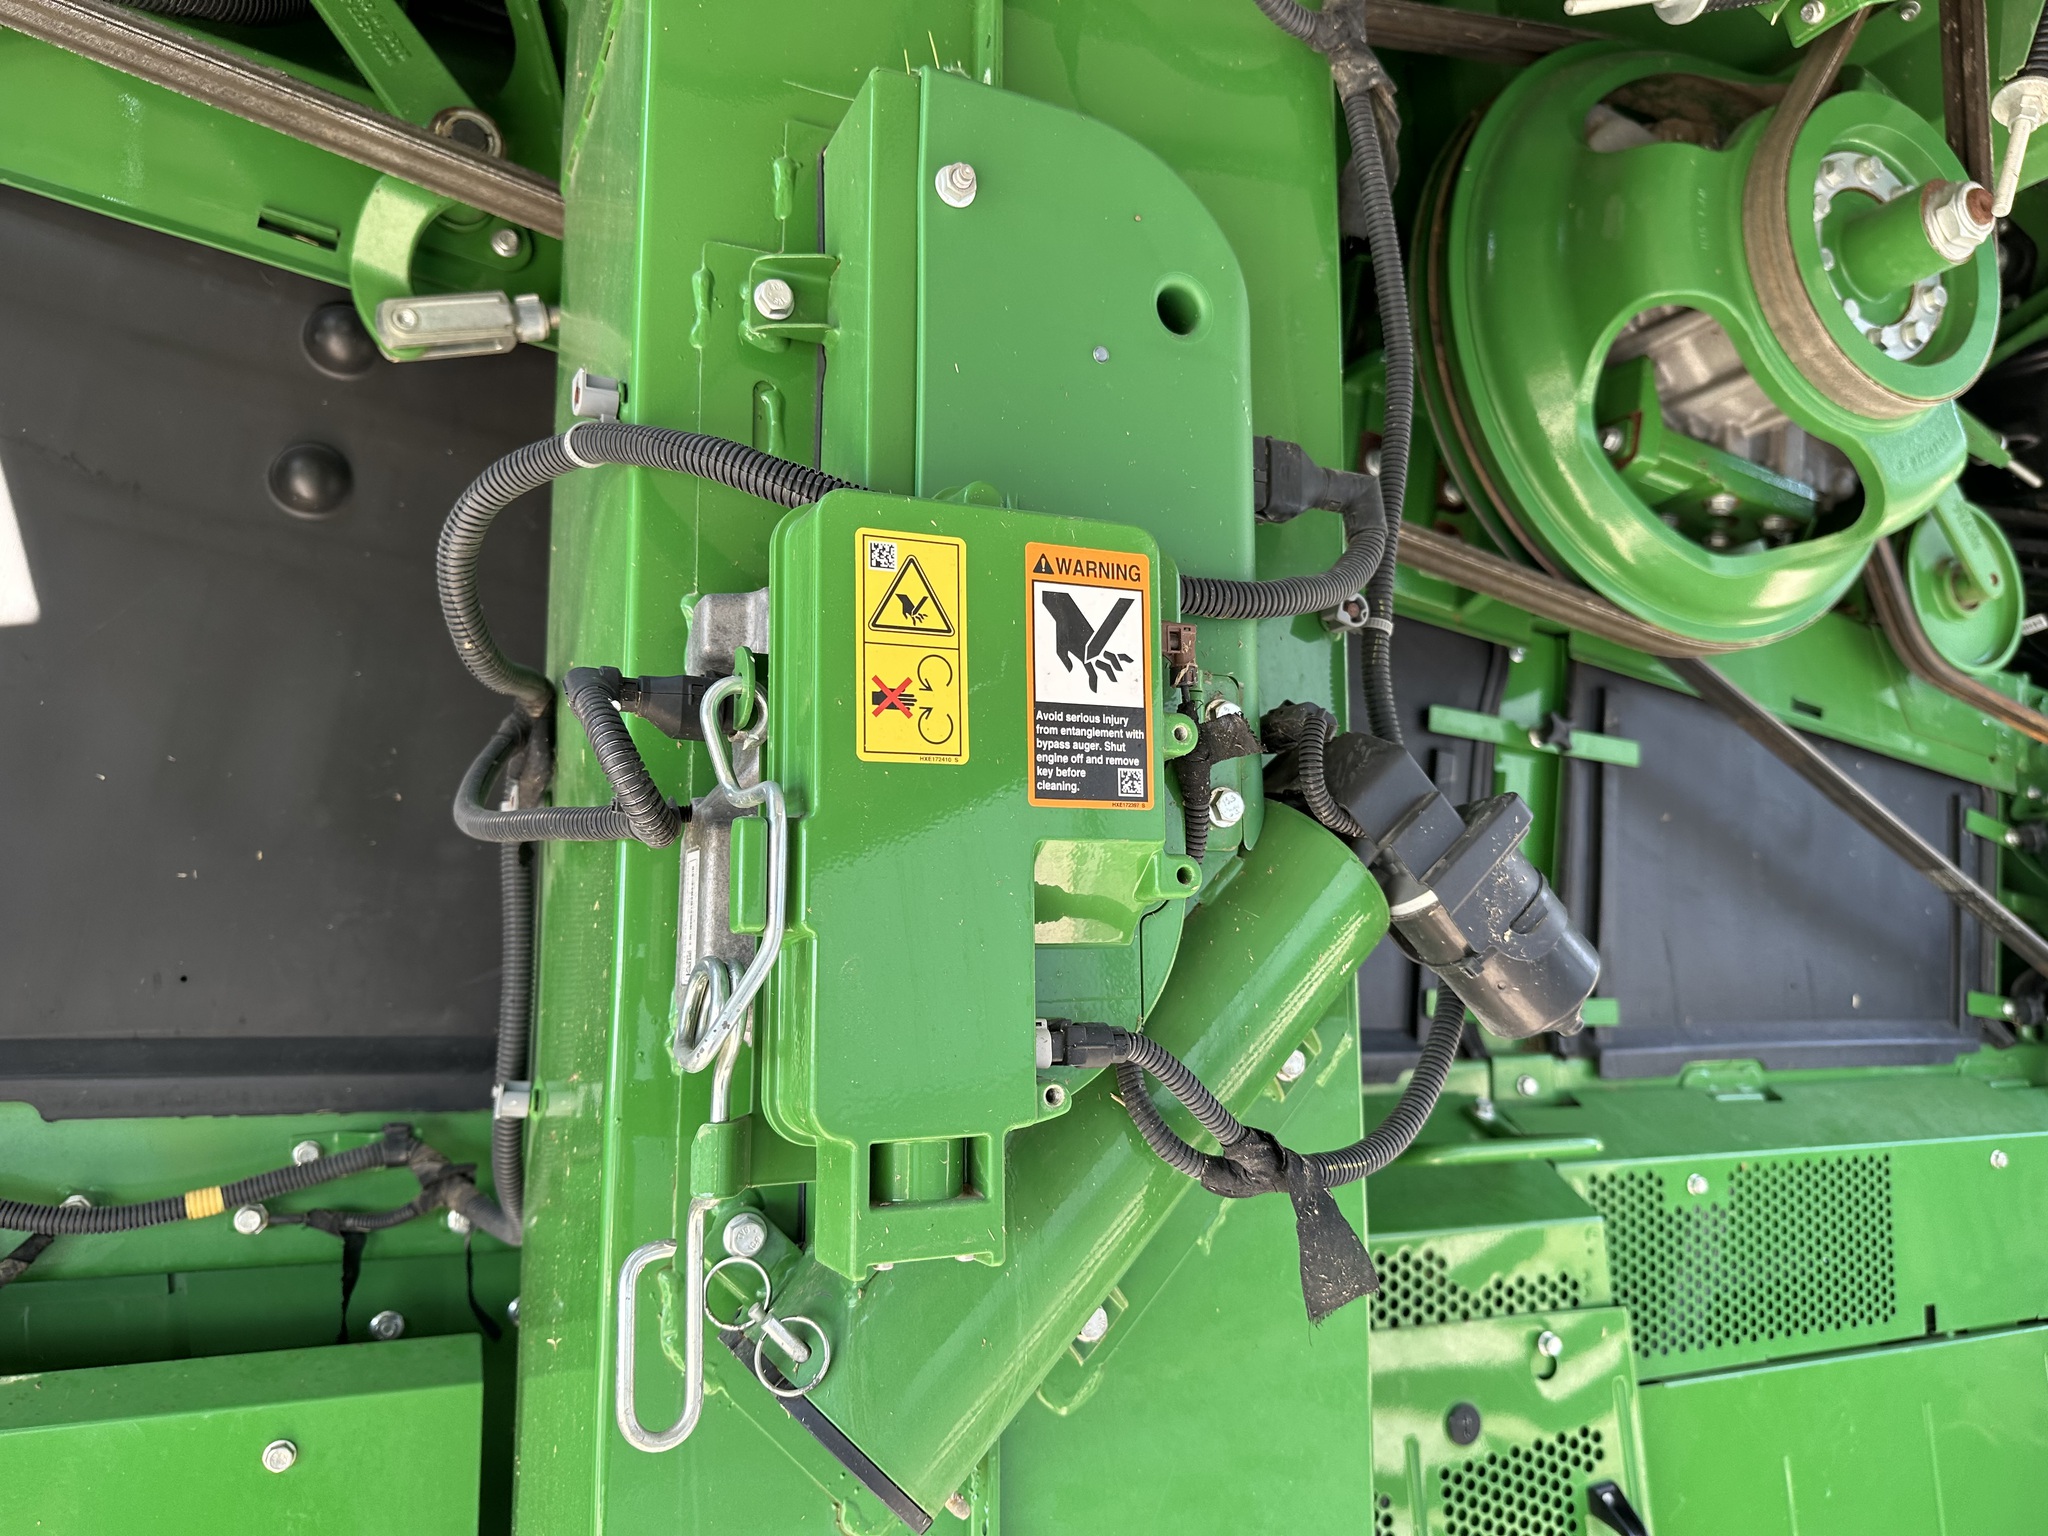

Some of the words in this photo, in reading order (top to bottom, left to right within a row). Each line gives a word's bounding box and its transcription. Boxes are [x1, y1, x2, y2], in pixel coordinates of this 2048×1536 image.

[1055, 557, 1141, 582] WARNING
[1036, 710, 1063, 721] Avoid
[1066, 713, 1100, 723] serious
[1103, 714, 1129, 727] injury
[1036, 724, 1058, 735] from
[1061, 727, 1123, 739] entanglement
[1125, 729, 1144, 739] with
[1036, 738, 1070, 750] bypass
[1073, 742, 1102, 752] auger.
[1104, 741, 1126, 751] Shut
[1036, 753, 1068, 764] engine
[1071, 754, 1084, 763] off
[1086, 755, 1103, 764] and
[1106, 757, 1139, 765] remove
[1037, 766, 1053, 778] key
[1056, 767, 1086, 777] before
[1037, 780, 1080, 793] cleaning.
